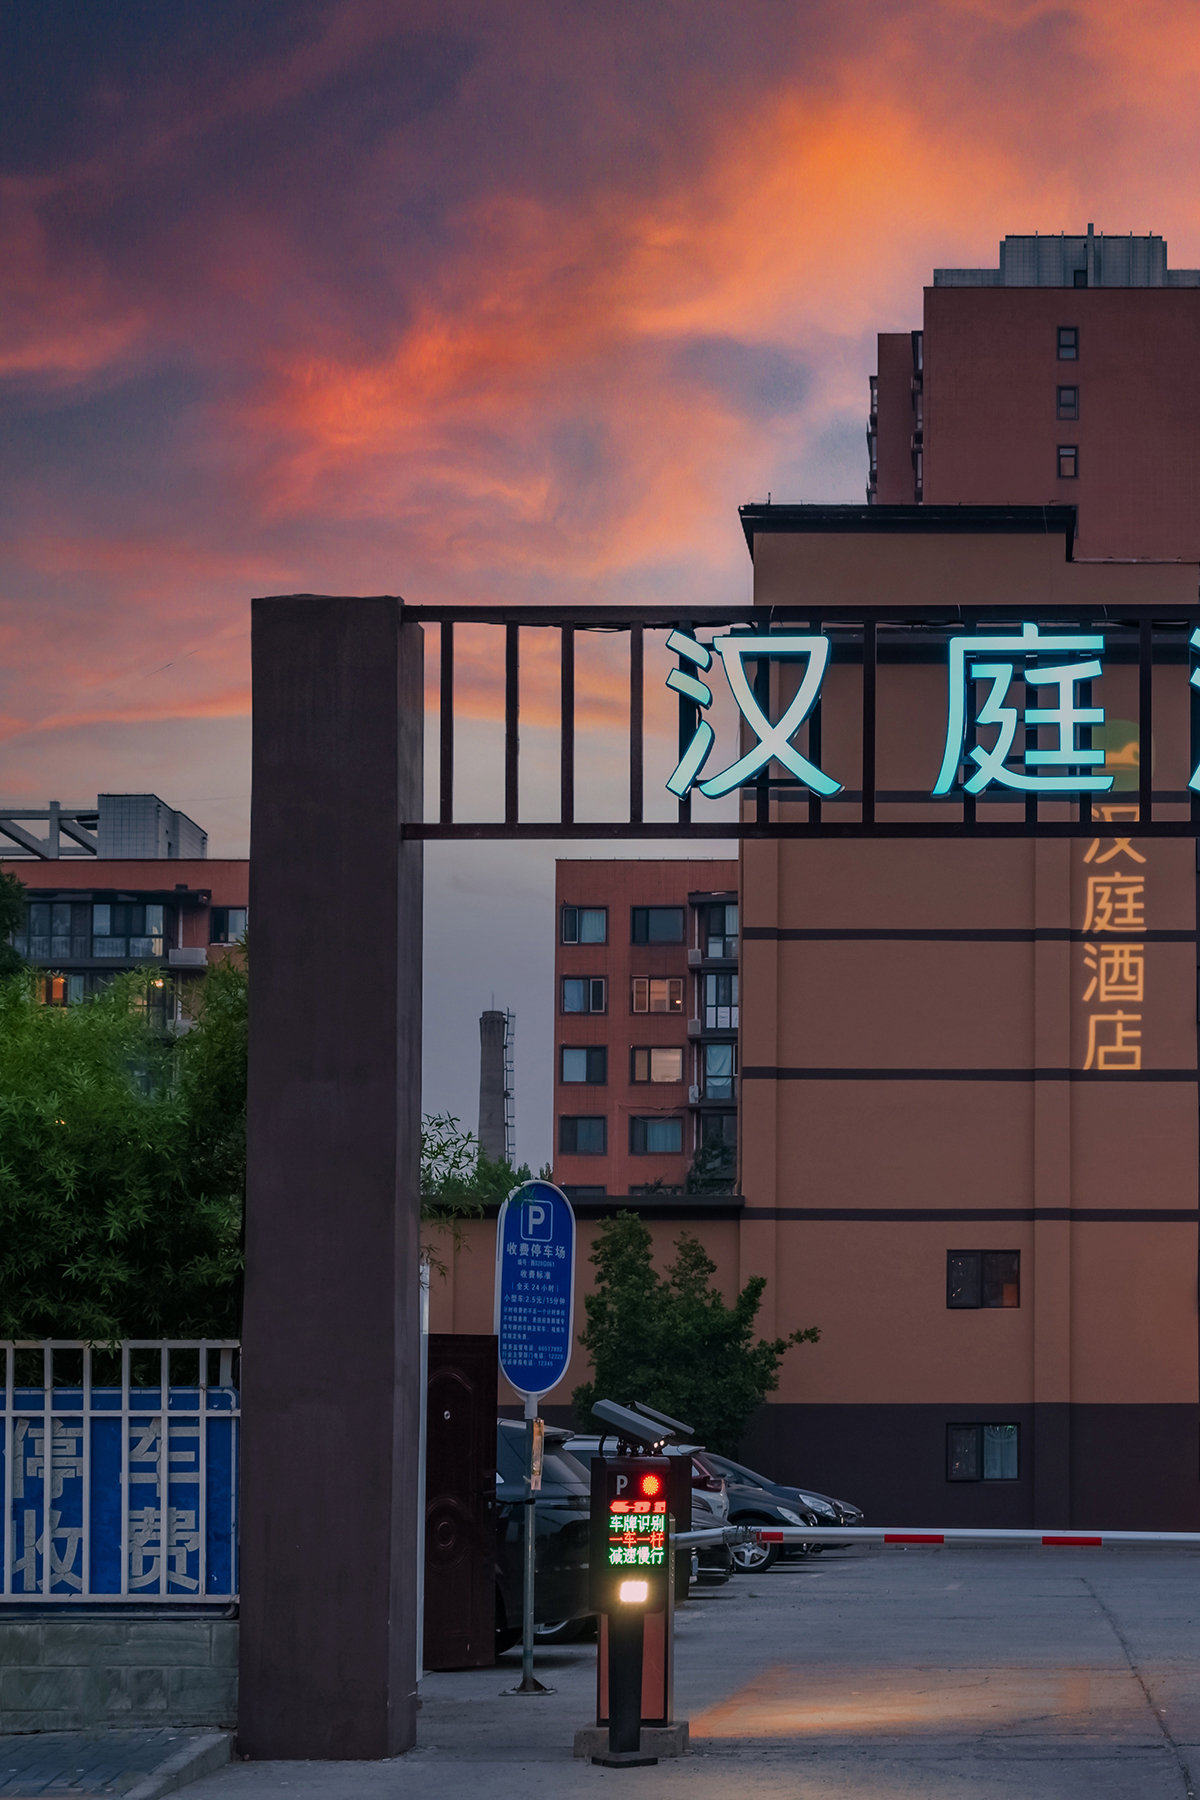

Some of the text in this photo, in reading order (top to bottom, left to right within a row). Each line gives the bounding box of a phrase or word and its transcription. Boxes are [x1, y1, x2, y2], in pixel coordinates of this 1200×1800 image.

[1082, 805, 1148, 1071] 汉庭酒店
[528, 1205, 545, 1235] P
[507, 1242, 566, 1259] 收费停车场
[520, 1269, 551, 1280] 收费标准
[616, 1475, 628, 1495] P
[609, 1515, 665, 1532] 车牌识别
[609, 1531, 665, 1549] 一车一杆
[609, 1547, 664, 1565] 减速慢行
